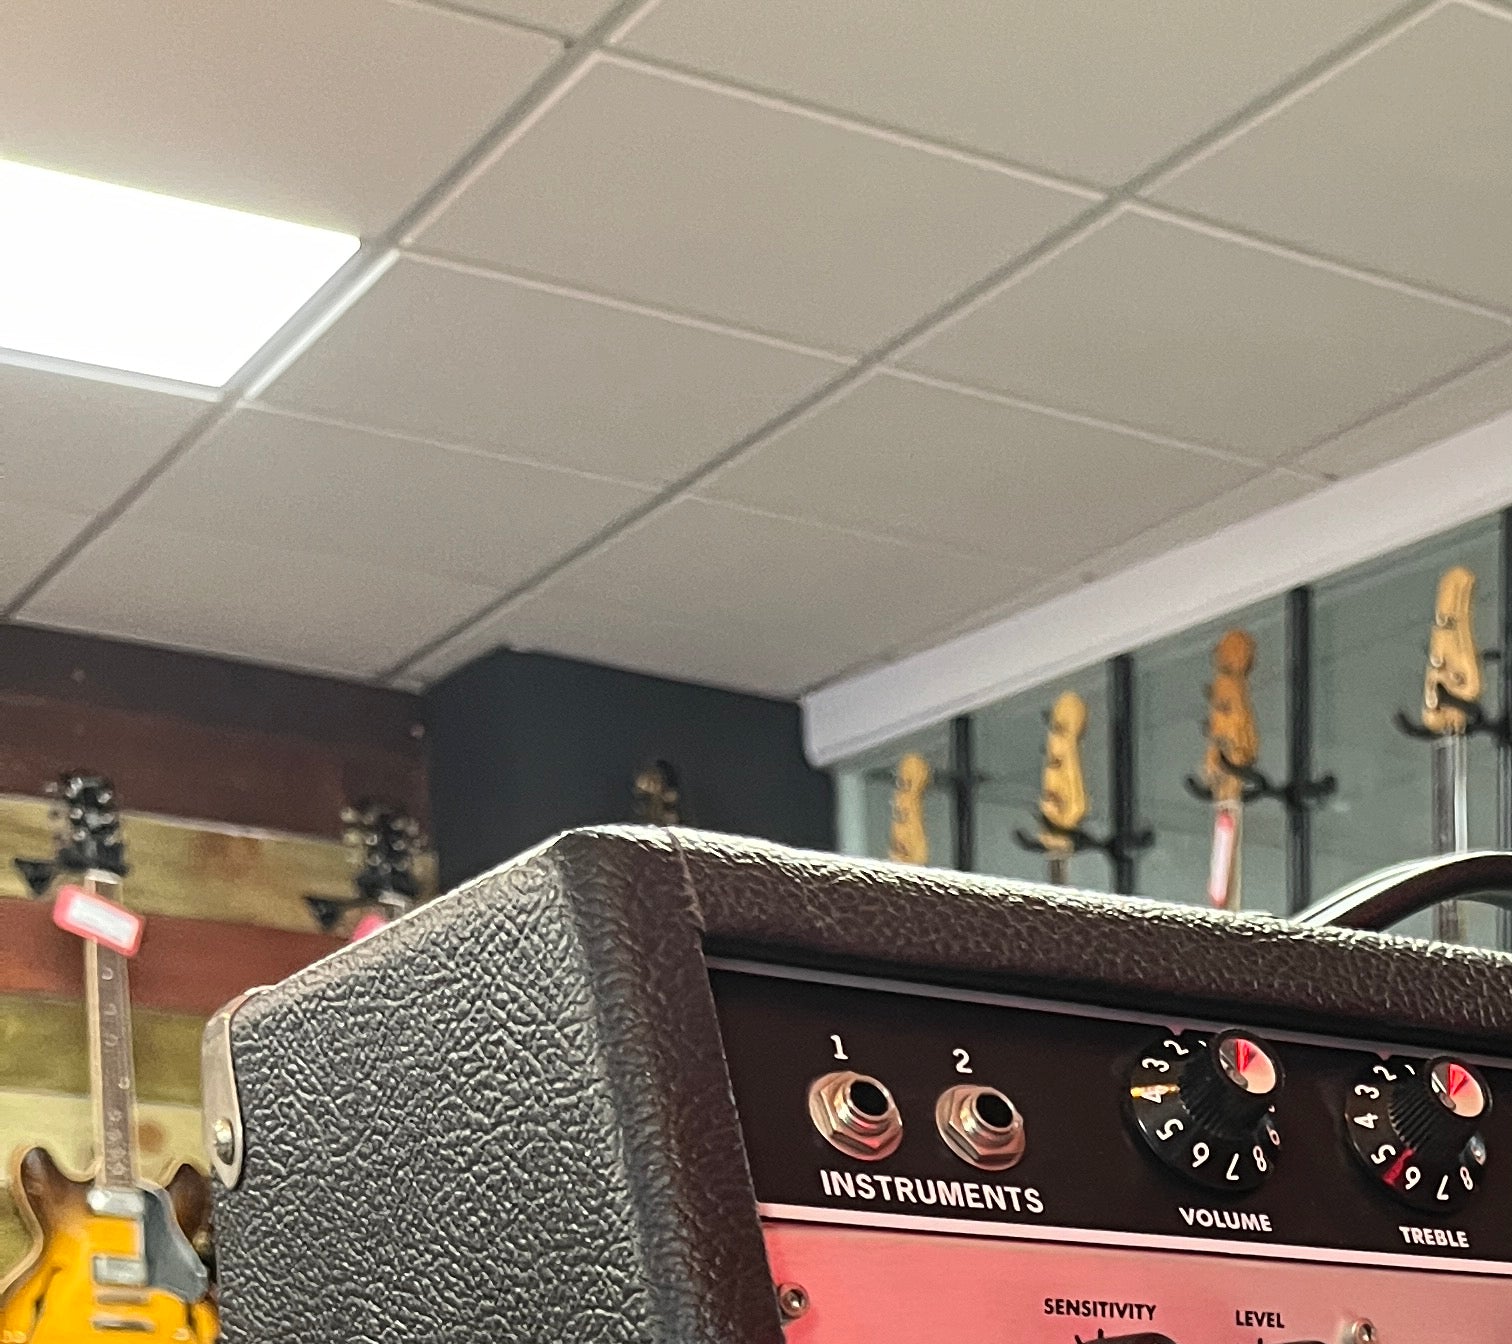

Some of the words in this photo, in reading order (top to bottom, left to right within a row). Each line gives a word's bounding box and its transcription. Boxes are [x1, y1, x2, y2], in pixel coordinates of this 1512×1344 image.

[830, 1034, 849, 1060] 1
[952, 1048, 973, 1074] 2
[1141, 1057, 1170, 1073] 3
[1354, 1084, 1380, 1100] 3
[1155, 1118, 1184, 1141] 5
[1353, 1112, 1379, 1129] 4
[1226, 1153, 1240, 1181] 7
[1252, 1145, 1267, 1172] 8
[1370, 1144, 1396, 1165] 5
[1436, 1174, 1449, 1201] 7
[1460, 1166, 1474, 1191] 8
[820, 1169, 1044, 1214] INSTRUMENTS
[1178, 1207, 1273, 1233] VOLUME
[1399, 1226, 1470, 1248] TREBLE
[1043, 1297, 1157, 1322] SENSITIVITY
[1234, 1309, 1286, 1331] LEVEL
